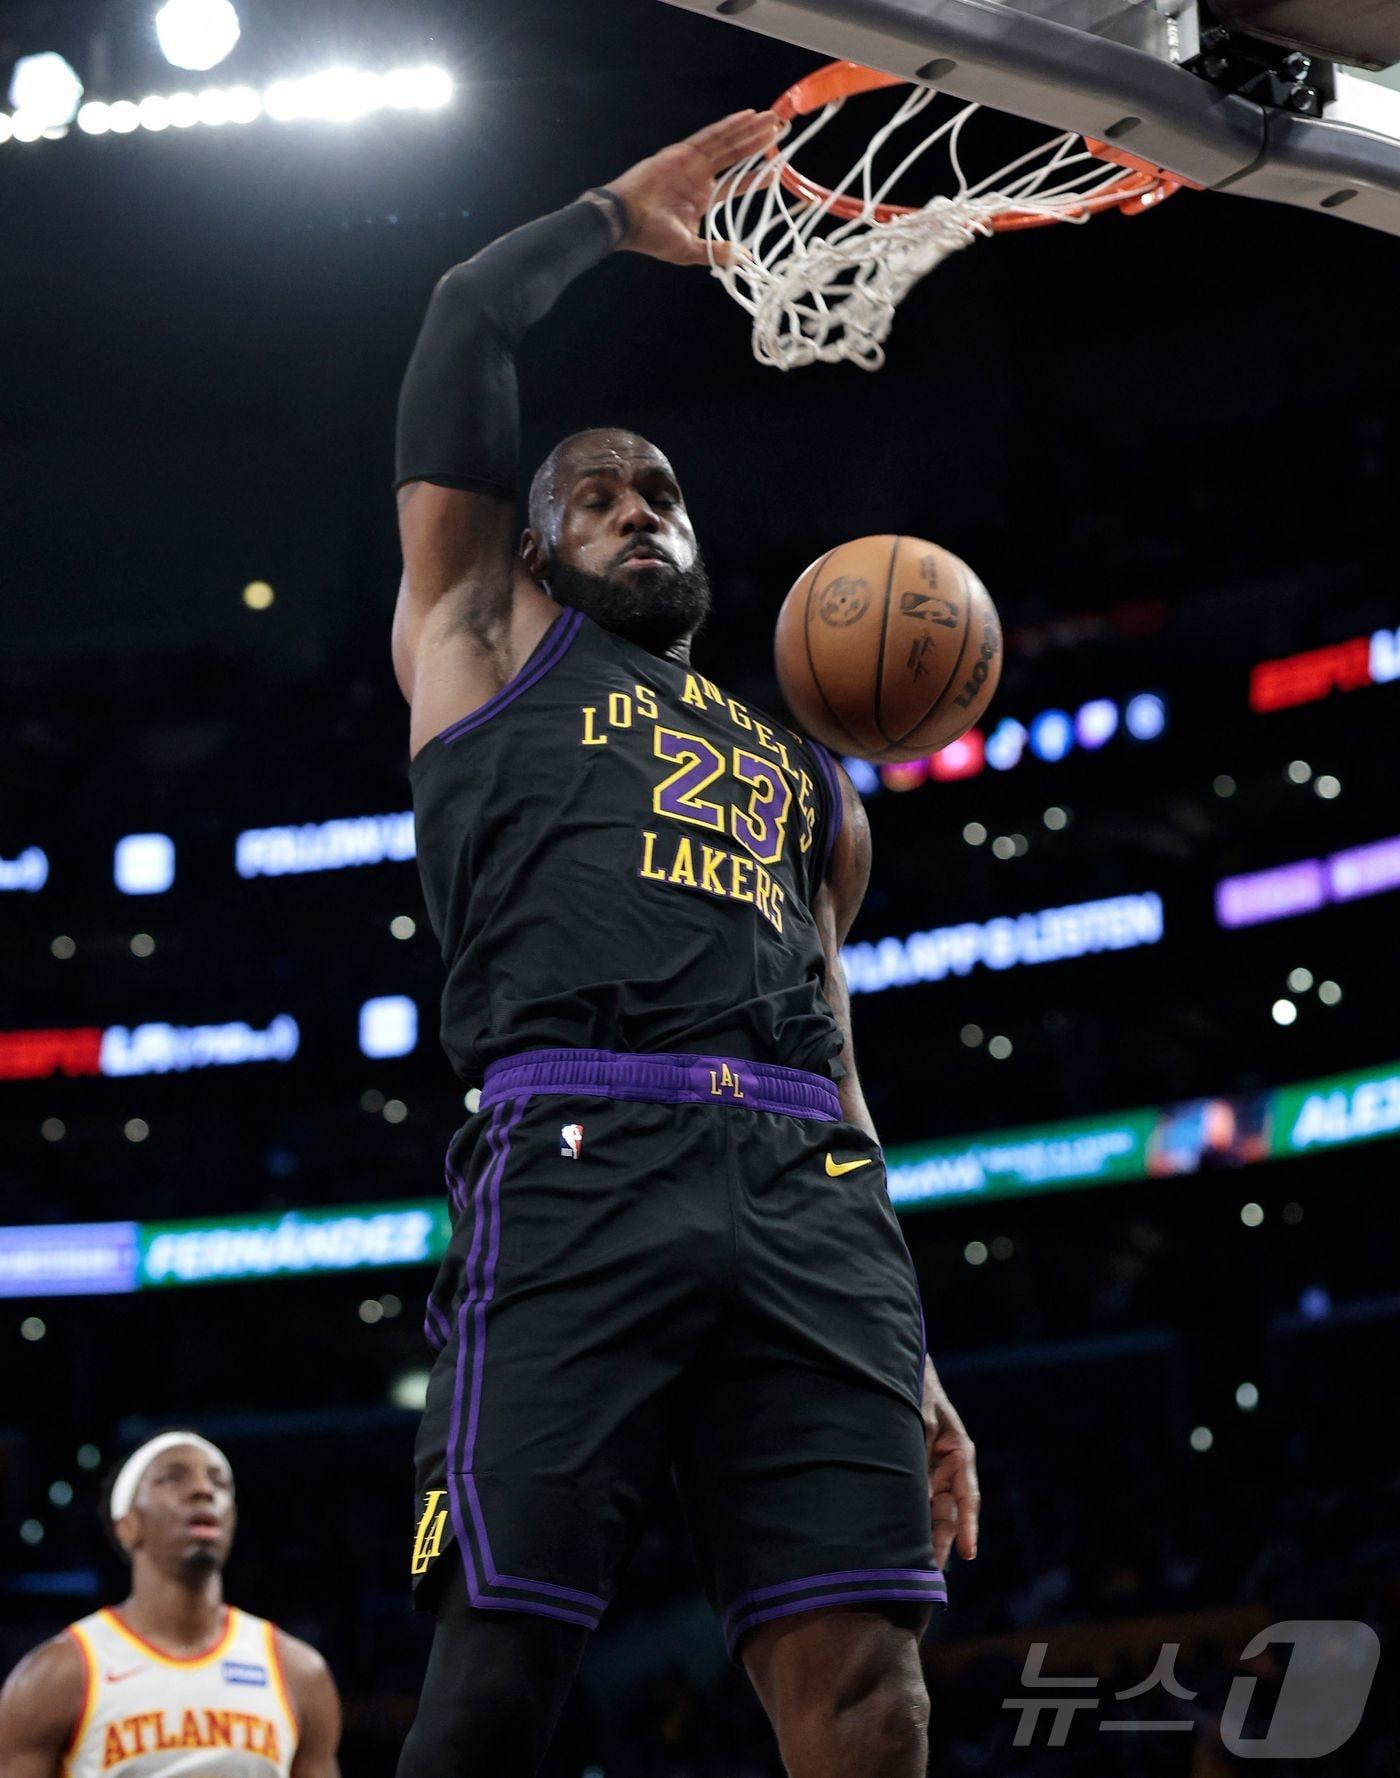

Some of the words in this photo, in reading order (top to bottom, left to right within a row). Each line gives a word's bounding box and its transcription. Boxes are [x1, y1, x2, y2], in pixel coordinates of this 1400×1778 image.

[581, 684, 659, 746] LOS
[680, 672, 816, 854] ANGELES
[652, 723, 793, 866] 23
[639, 831, 785, 935] LAKERS
[709, 1062, 745, 1099] LAL
[411, 1490, 448, 1574] LA
[103, 1708, 281, 1771] ATLANTA
